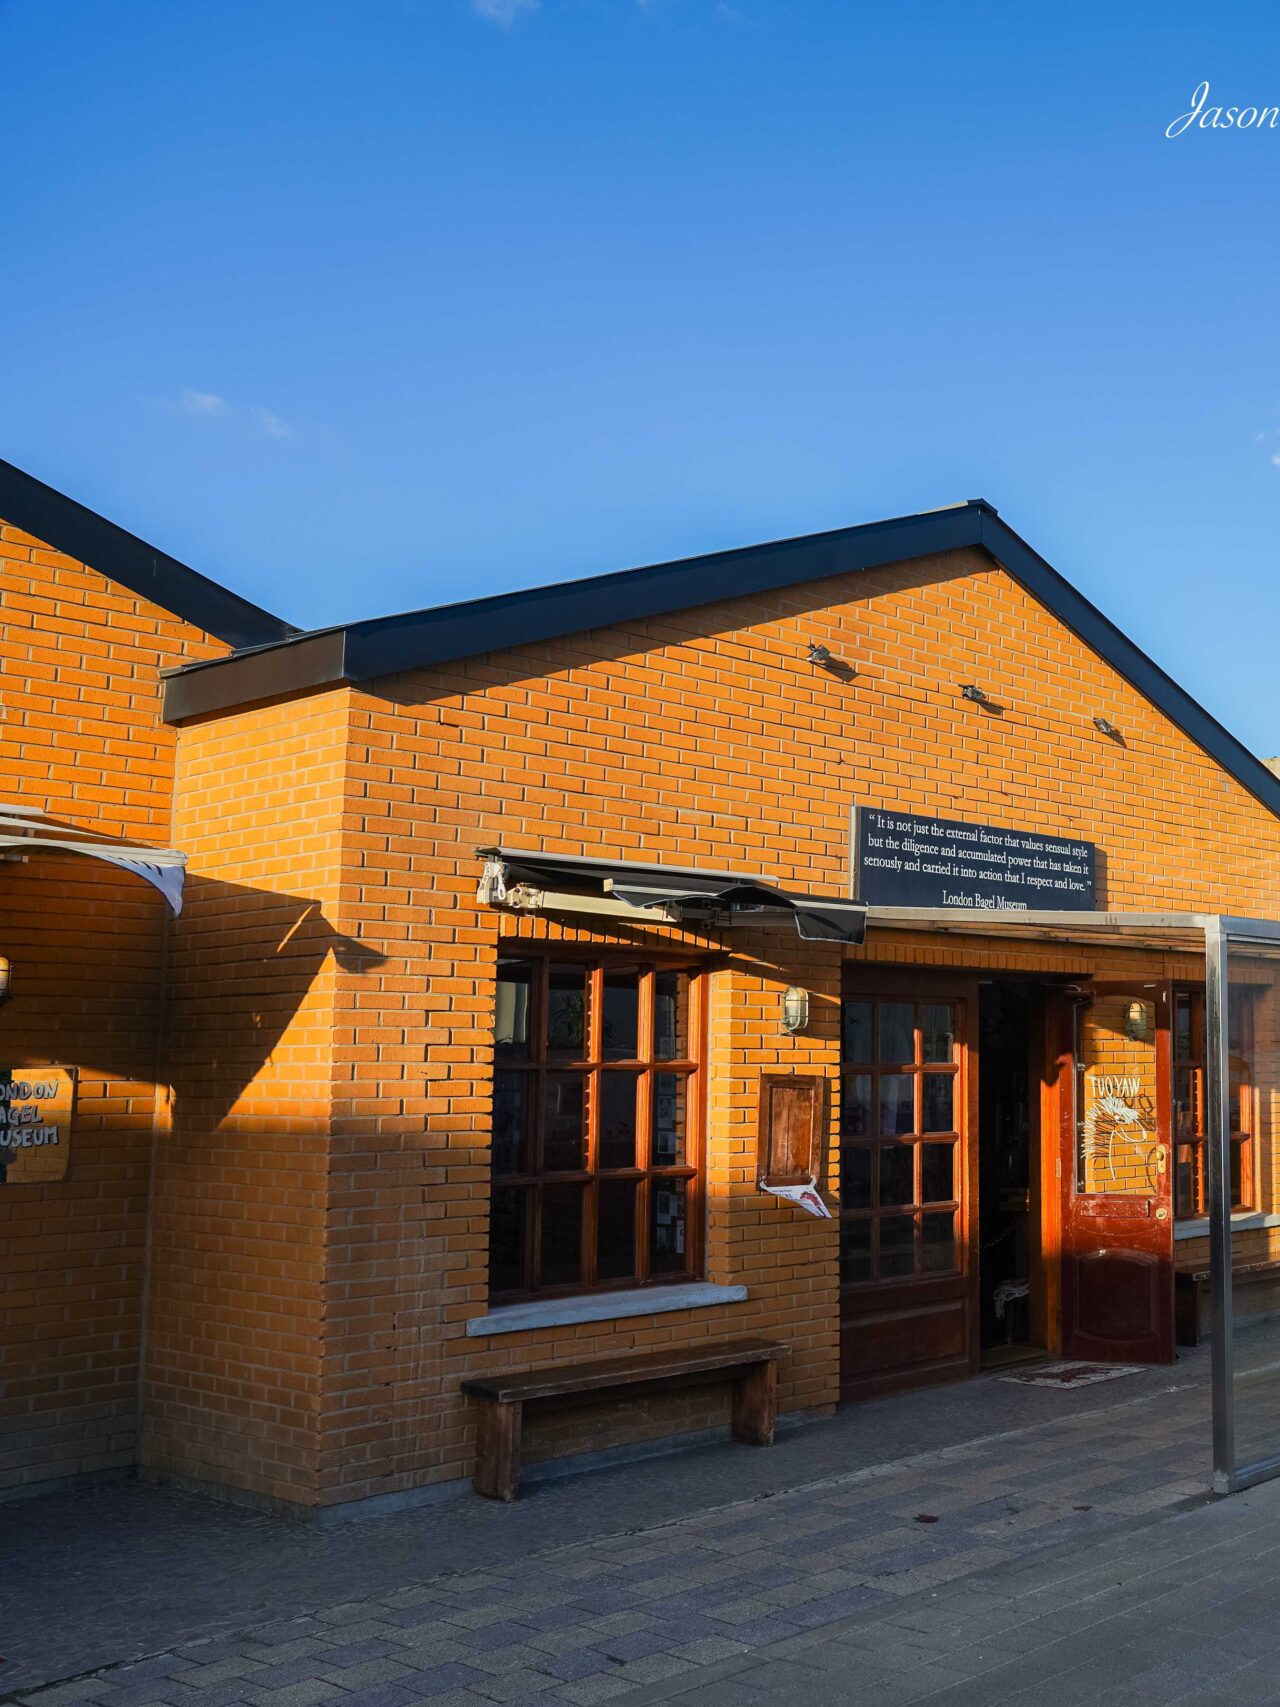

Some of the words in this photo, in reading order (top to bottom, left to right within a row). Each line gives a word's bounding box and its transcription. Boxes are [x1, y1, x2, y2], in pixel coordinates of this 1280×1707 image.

[868, 833, 883, 847] but
[885, 836, 899, 849] the
[902, 838, 939, 856] diligence
[941, 845, 956, 857] and
[958, 850, 1006, 864] accumulated
[1008, 856, 1031, 868] power
[1033, 857, 1047, 869] that
[1049, 858, 1061, 871] has
[1063, 861, 1082, 874] taken
[1083, 863, 1089, 874] it
[887, 817, 894, 829] is
[896, 821, 911, 832] not
[913, 820, 929, 836] just
[931, 824, 944, 836] the
[946, 829, 978, 841] external
[980, 831, 1003, 845] factor
[1005, 835, 1019, 847] that
[1021, 838, 1043, 851] values
[1045, 844, 1070, 855] sensual
[1072, 846, 1088, 860] style
[864, 856, 902, 872] seriously
[904, 859, 920, 871] and
[922, 862, 950, 875] carried
[953, 865, 959, 876] it
[960, 865, 977, 878] into
[979, 868, 1002, 881] action
[1005, 871, 1019, 883] that
[1021, 873, 1025, 884] I
[1027, 876, 1053, 889] respect
[1055, 878, 1067, 889] and
[942, 890, 973, 906] London
[975, 894, 995, 909] Bagel
[997, 896, 1028, 910] Museum
